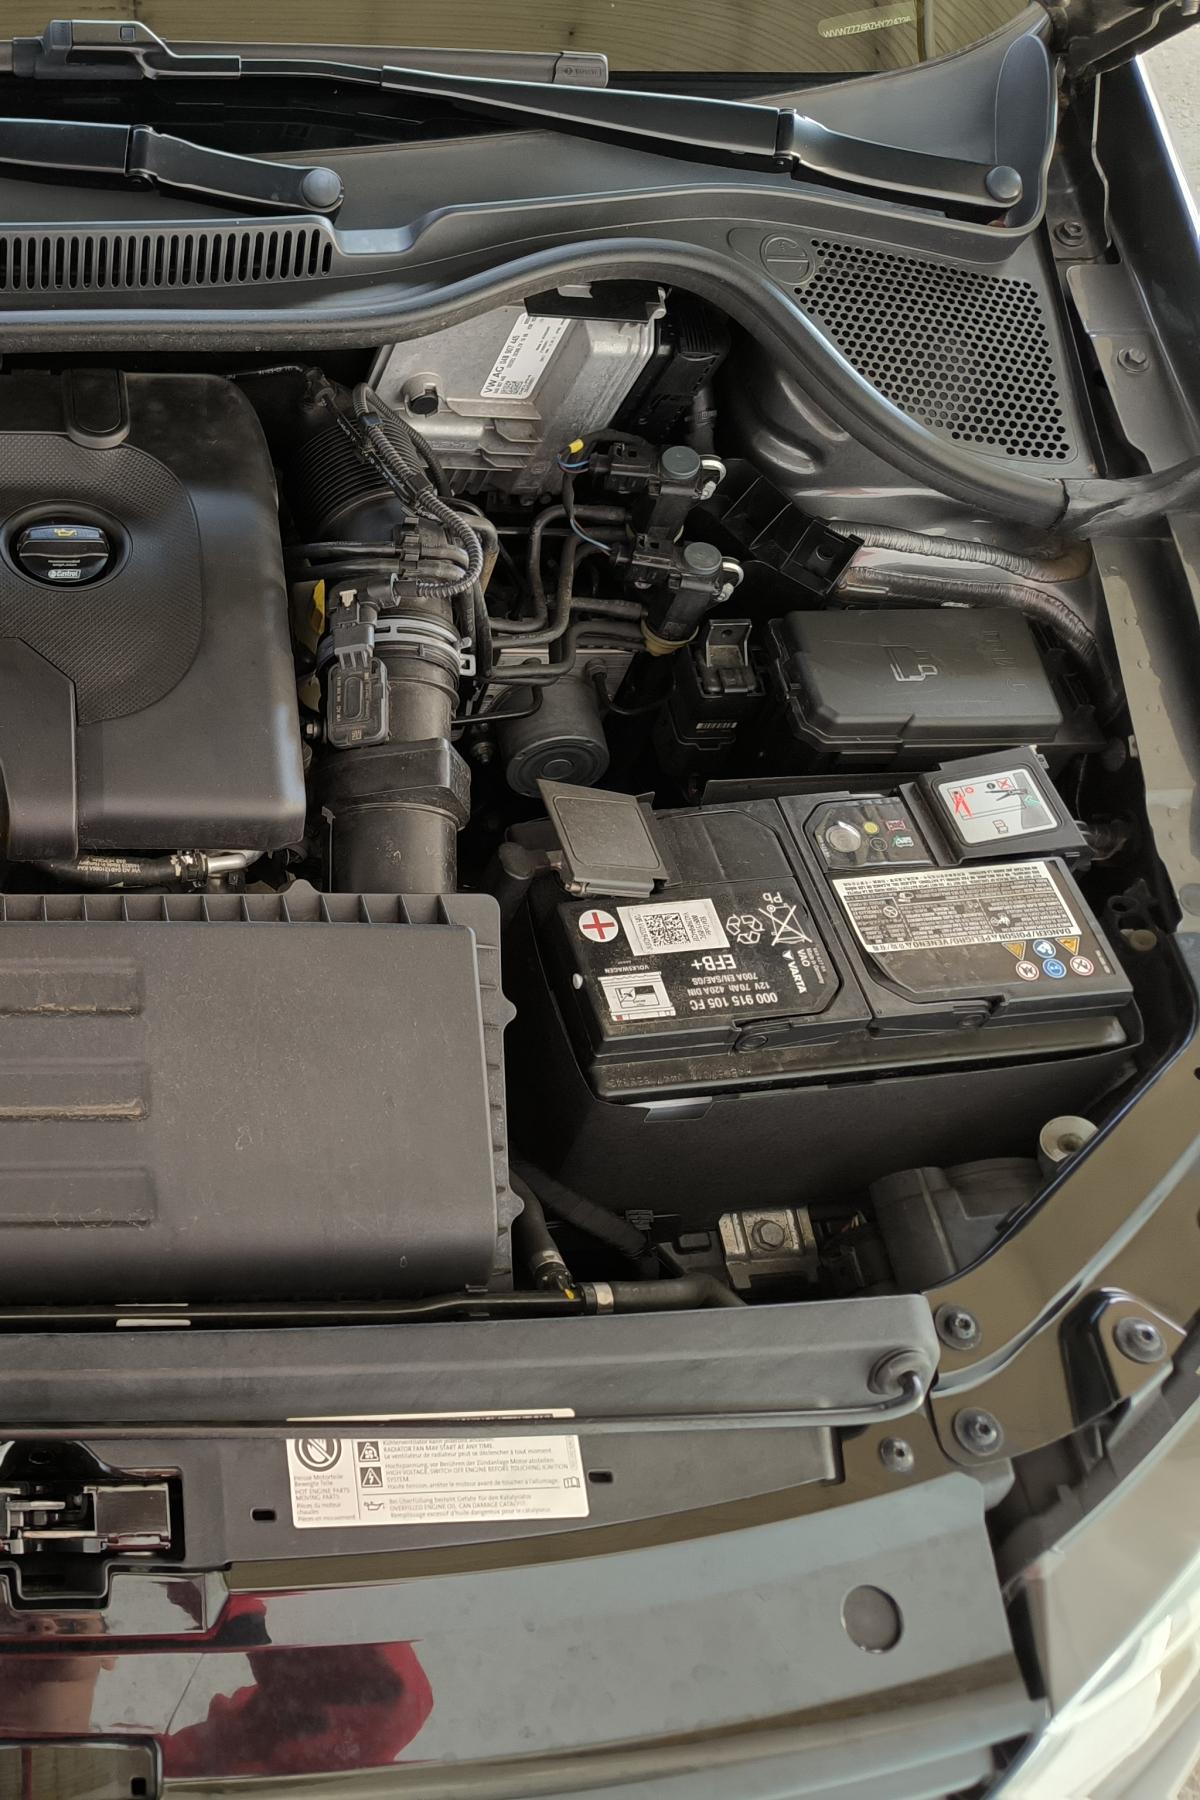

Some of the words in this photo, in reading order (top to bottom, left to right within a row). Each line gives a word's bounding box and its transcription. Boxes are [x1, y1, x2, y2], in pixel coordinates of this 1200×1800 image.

[483, 379, 497, 393] VW
[492, 366, 504, 378] AG
[762, 892, 782, 903] Pb
[691, 953, 737, 971] EFB+
[797, 949, 810, 966] VAO
[604, 964, 650, 973] VOLKSWAGEN
[691, 974, 735, 986] EN/SAE/GS
[736, 972, 758, 980] 700A
[788, 961, 807, 994] VARTA
[687, 987, 702, 996] DIN
[703, 985, 724, 995] 420A
[728, 983, 751, 992] 70Ah
[755, 981, 770, 990] 12V
[707, 997, 729, 1009] 105
[731, 994, 753, 1006] 915
[755, 992, 778, 1004] 000
[689, 998, 705, 1011] FC
